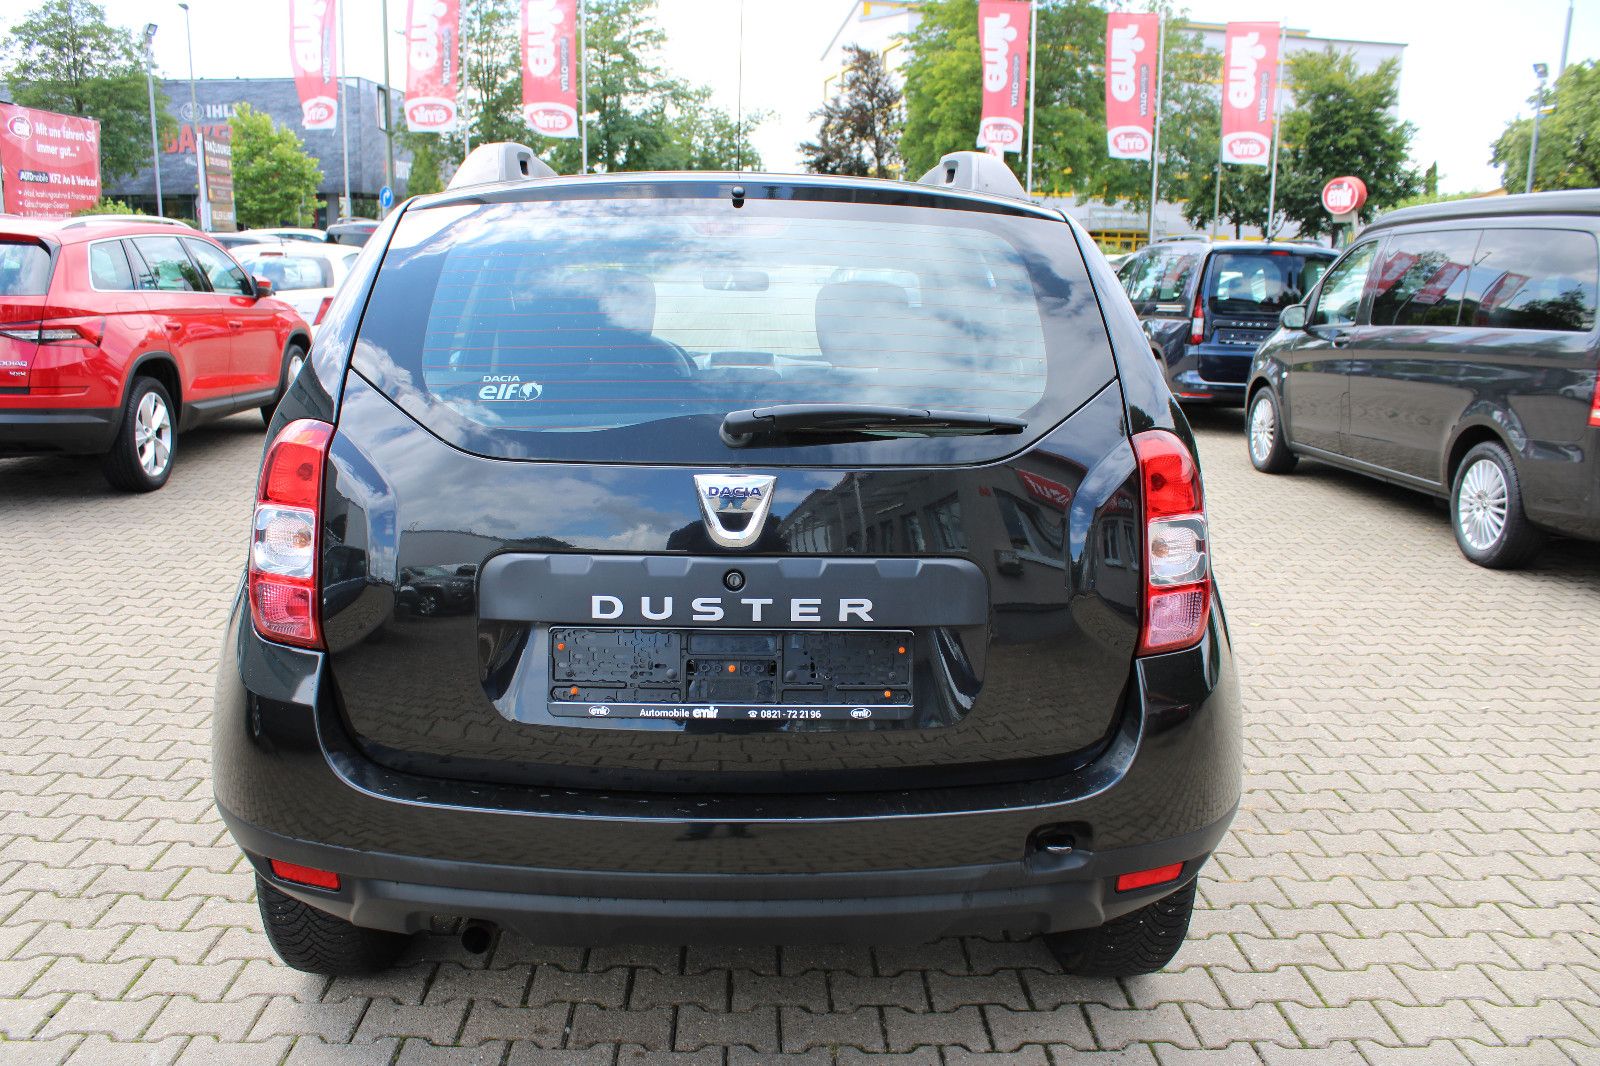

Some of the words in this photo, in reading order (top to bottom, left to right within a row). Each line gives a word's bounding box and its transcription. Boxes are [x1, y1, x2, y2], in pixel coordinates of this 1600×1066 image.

[35, 122, 48, 137] Mit
[478, 383, 520, 400] elf
[708, 486, 762, 498] DACIA
[591, 595, 875, 622] DUSTER
[639, 708, 690, 718] Automobile
[692, 705, 719, 719] emir
